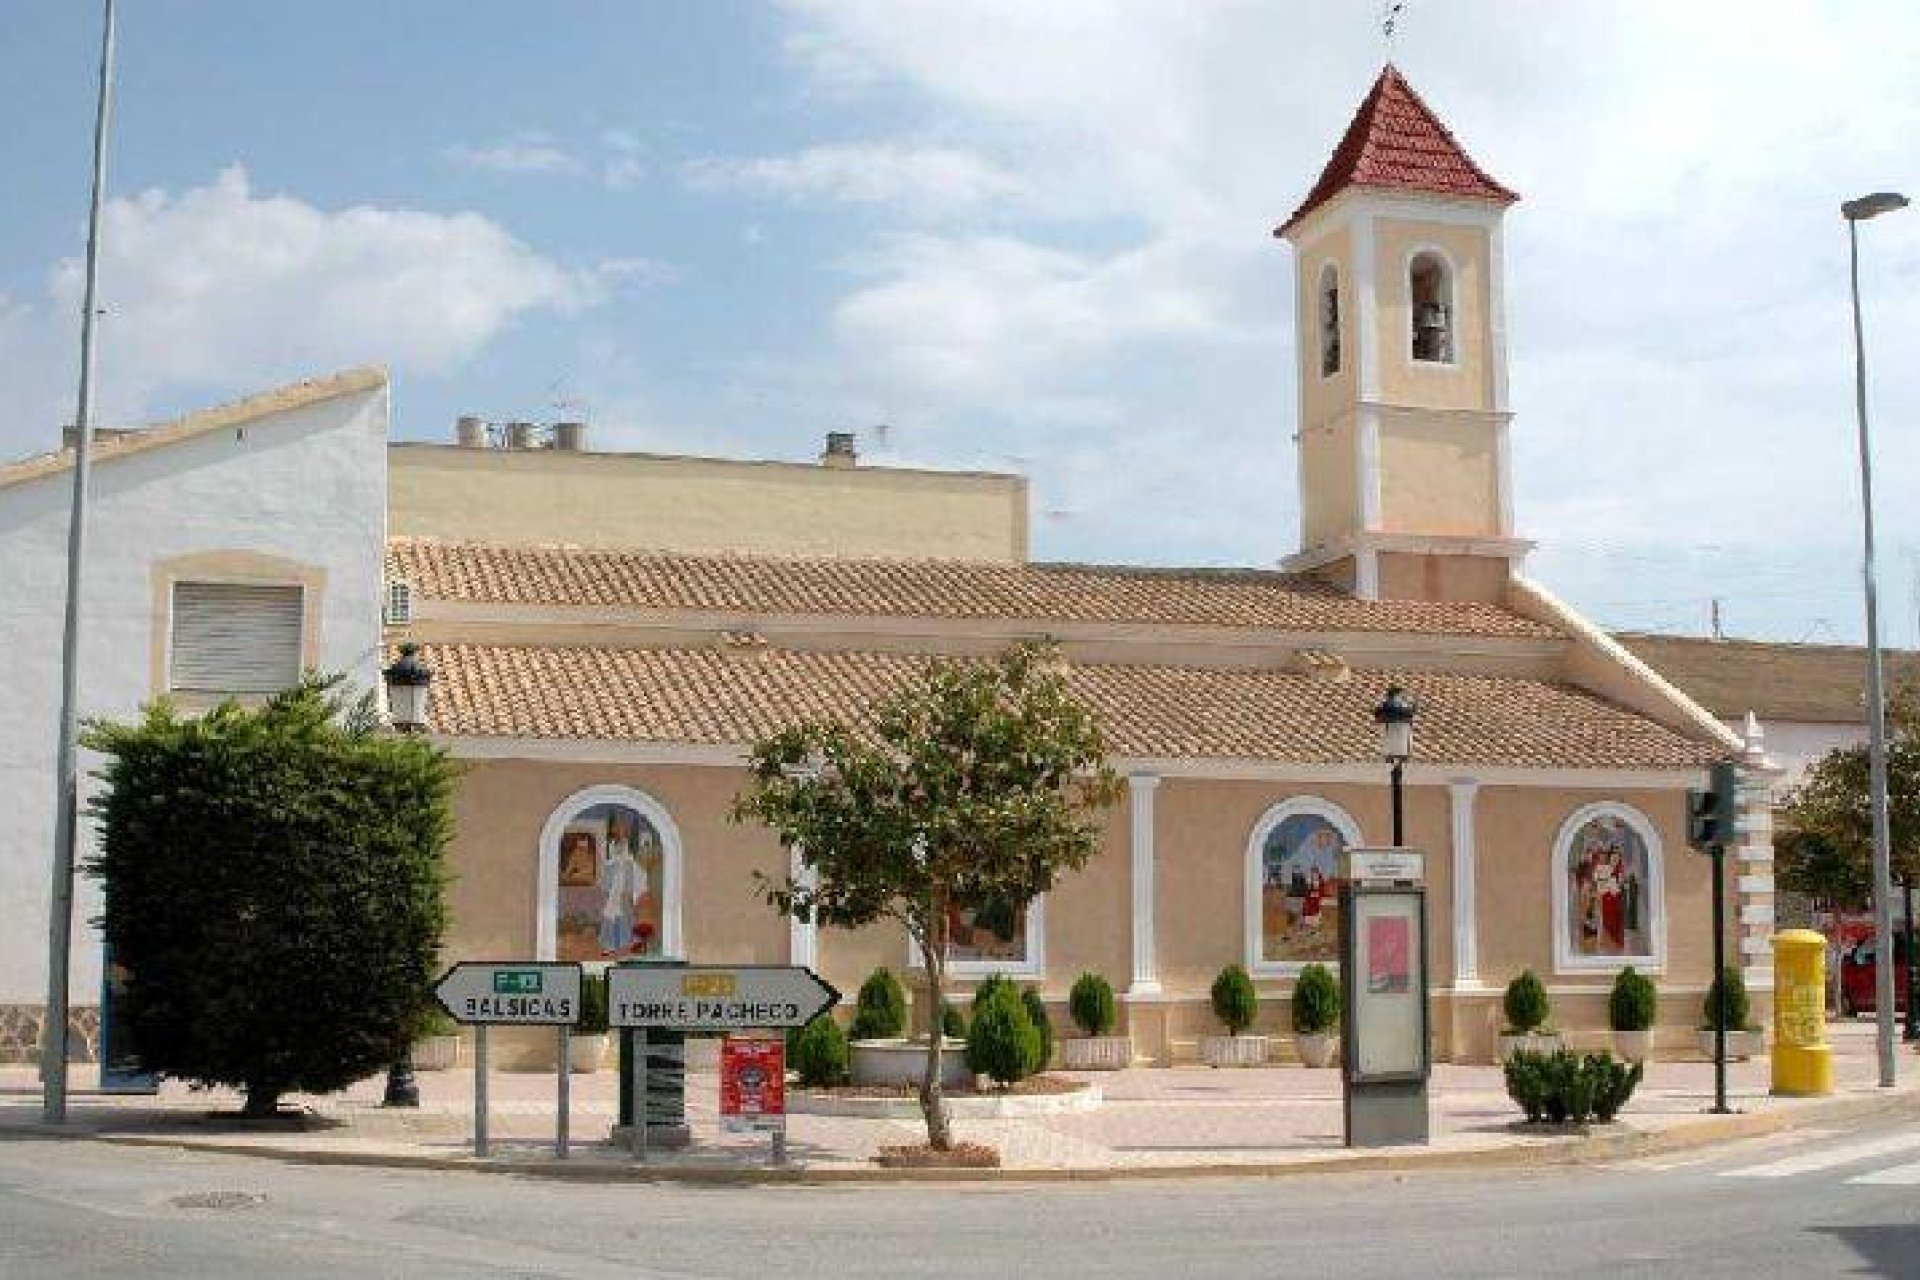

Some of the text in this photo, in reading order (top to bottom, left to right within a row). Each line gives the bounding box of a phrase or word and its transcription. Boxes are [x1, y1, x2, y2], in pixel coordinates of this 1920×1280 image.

[466, 998, 570, 1016] BALSICAS
[618, 1002, 799, 1019] TORRE PACHECO
